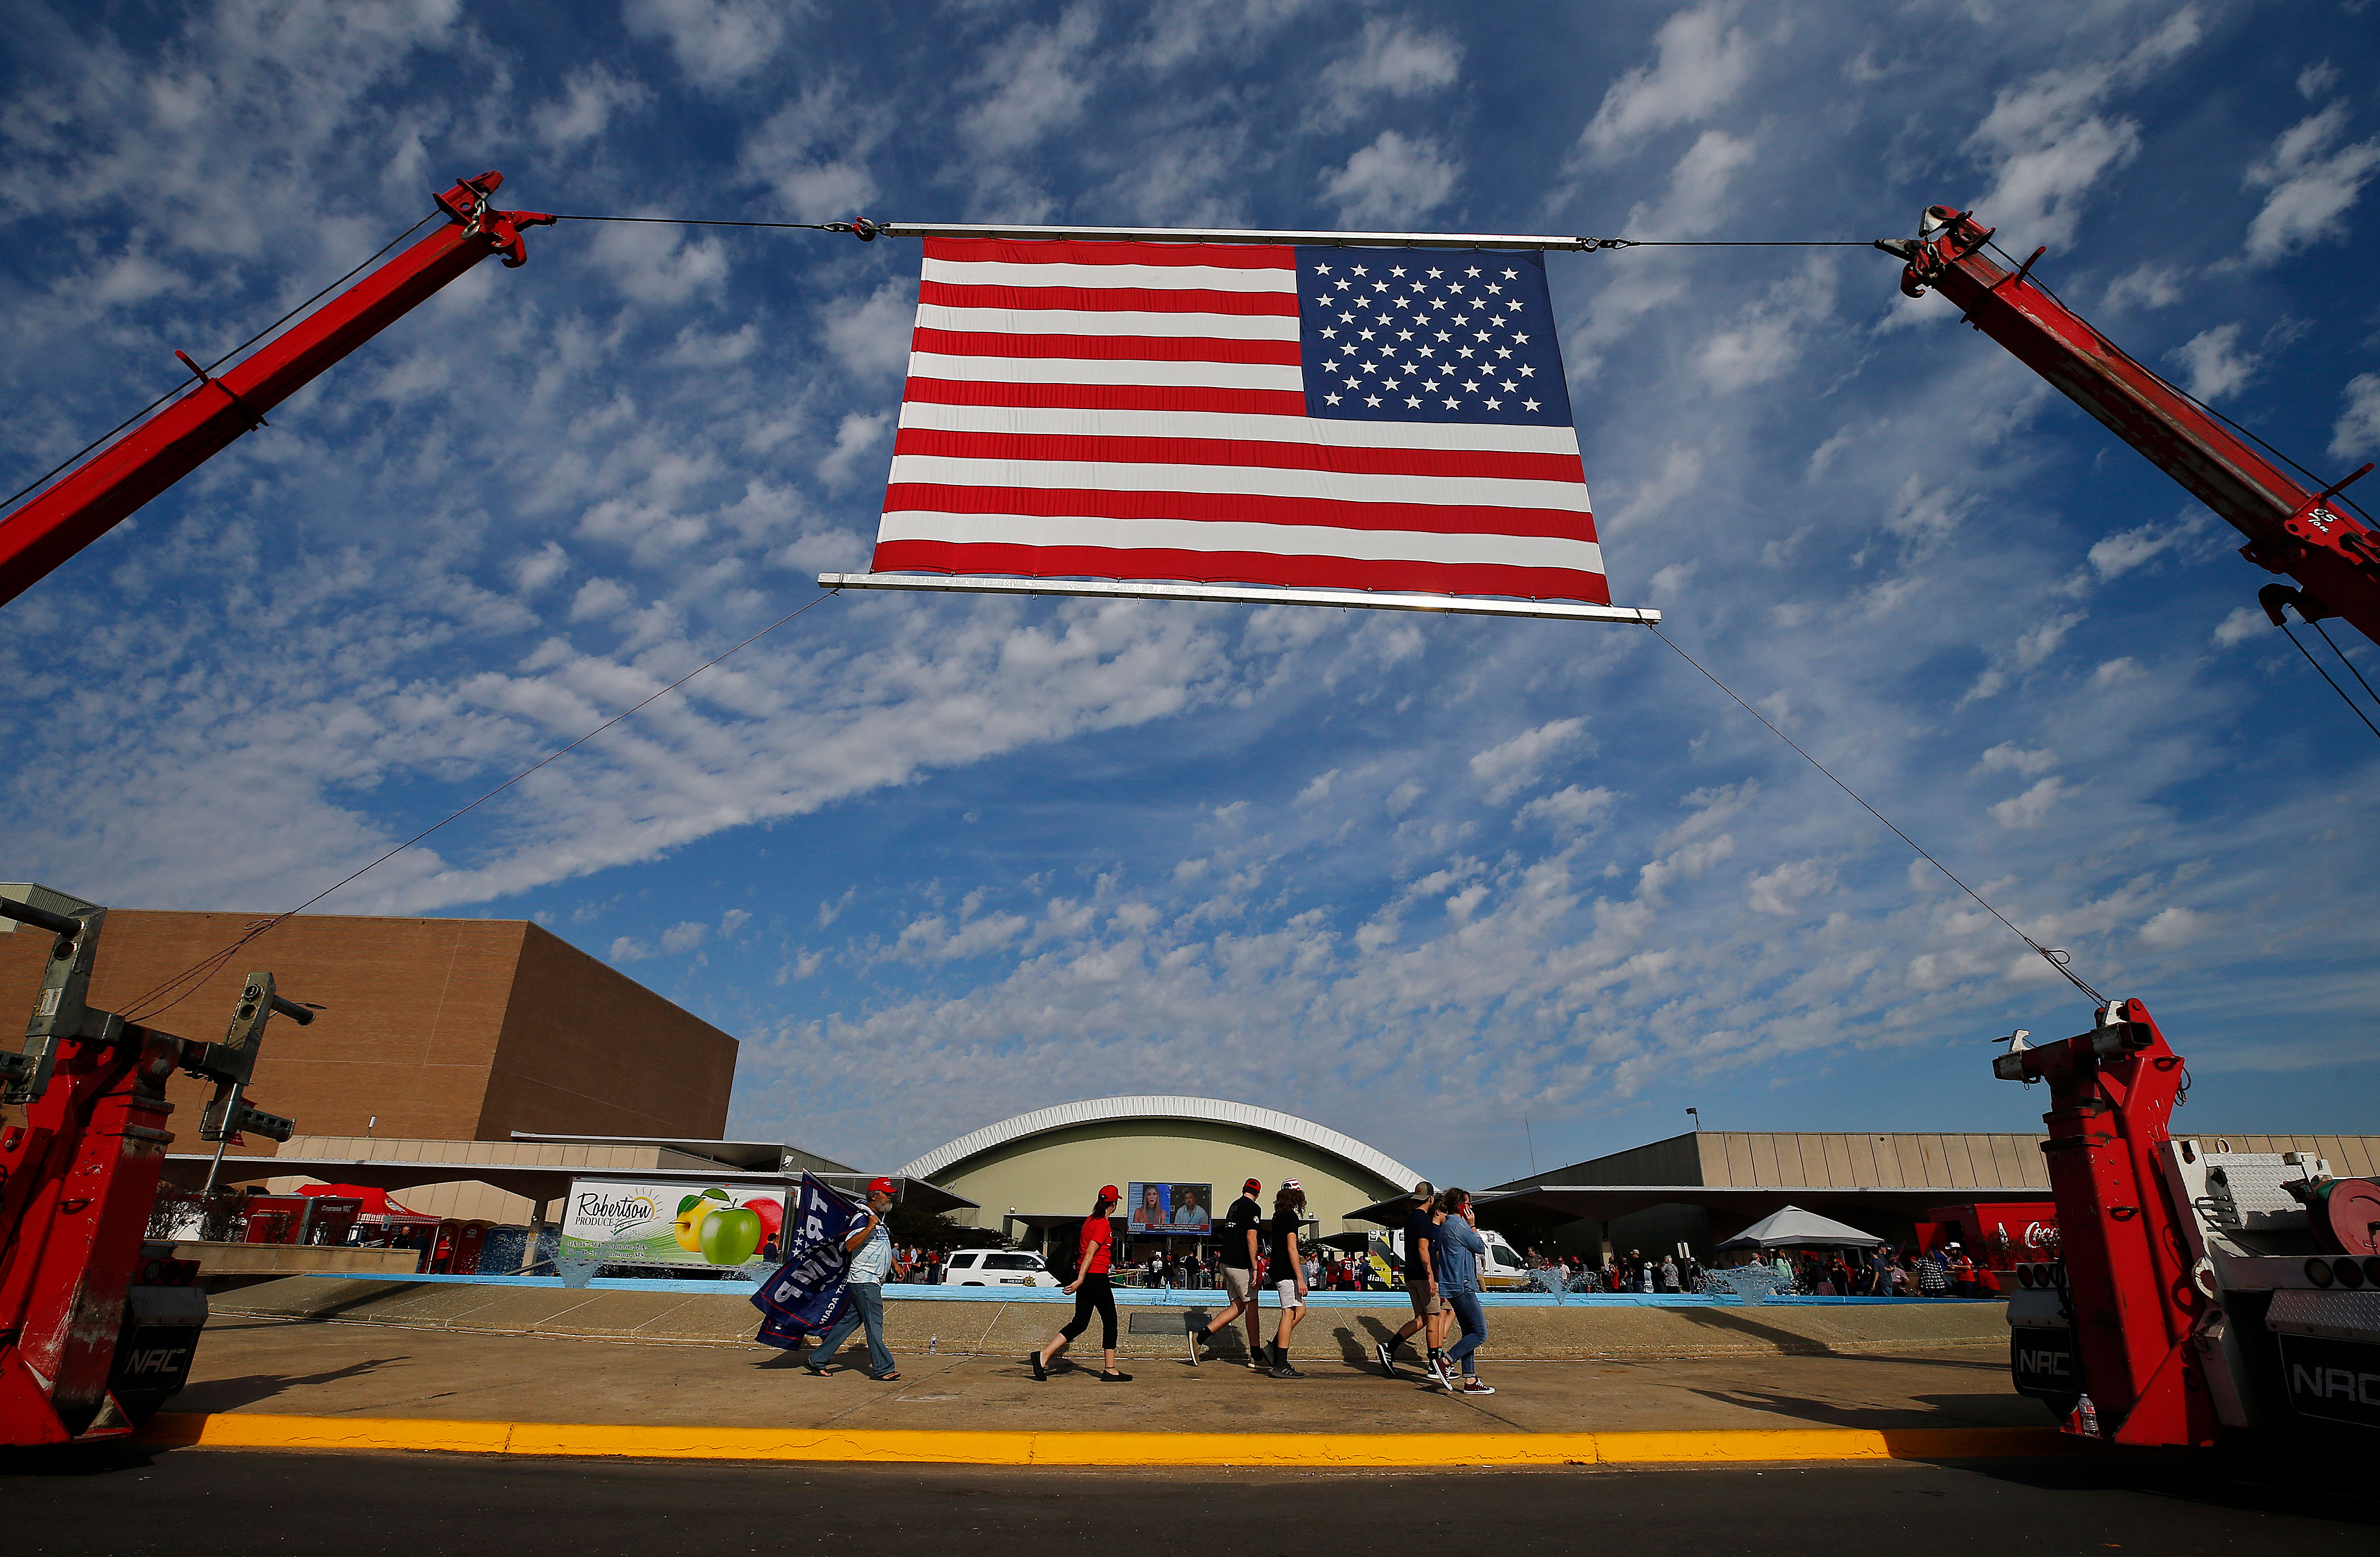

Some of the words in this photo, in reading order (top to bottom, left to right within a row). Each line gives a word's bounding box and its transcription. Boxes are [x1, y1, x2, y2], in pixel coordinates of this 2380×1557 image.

[2314, 508, 2338, 522] 65
[577, 1192, 652, 1218] Robertson
[575, 1216, 613, 1227] PRODUCE
[124, 1348, 186, 1375] NRC
[2020, 1349, 2069, 1376] NRC
[2293, 1364, 2380, 1405] NRC
